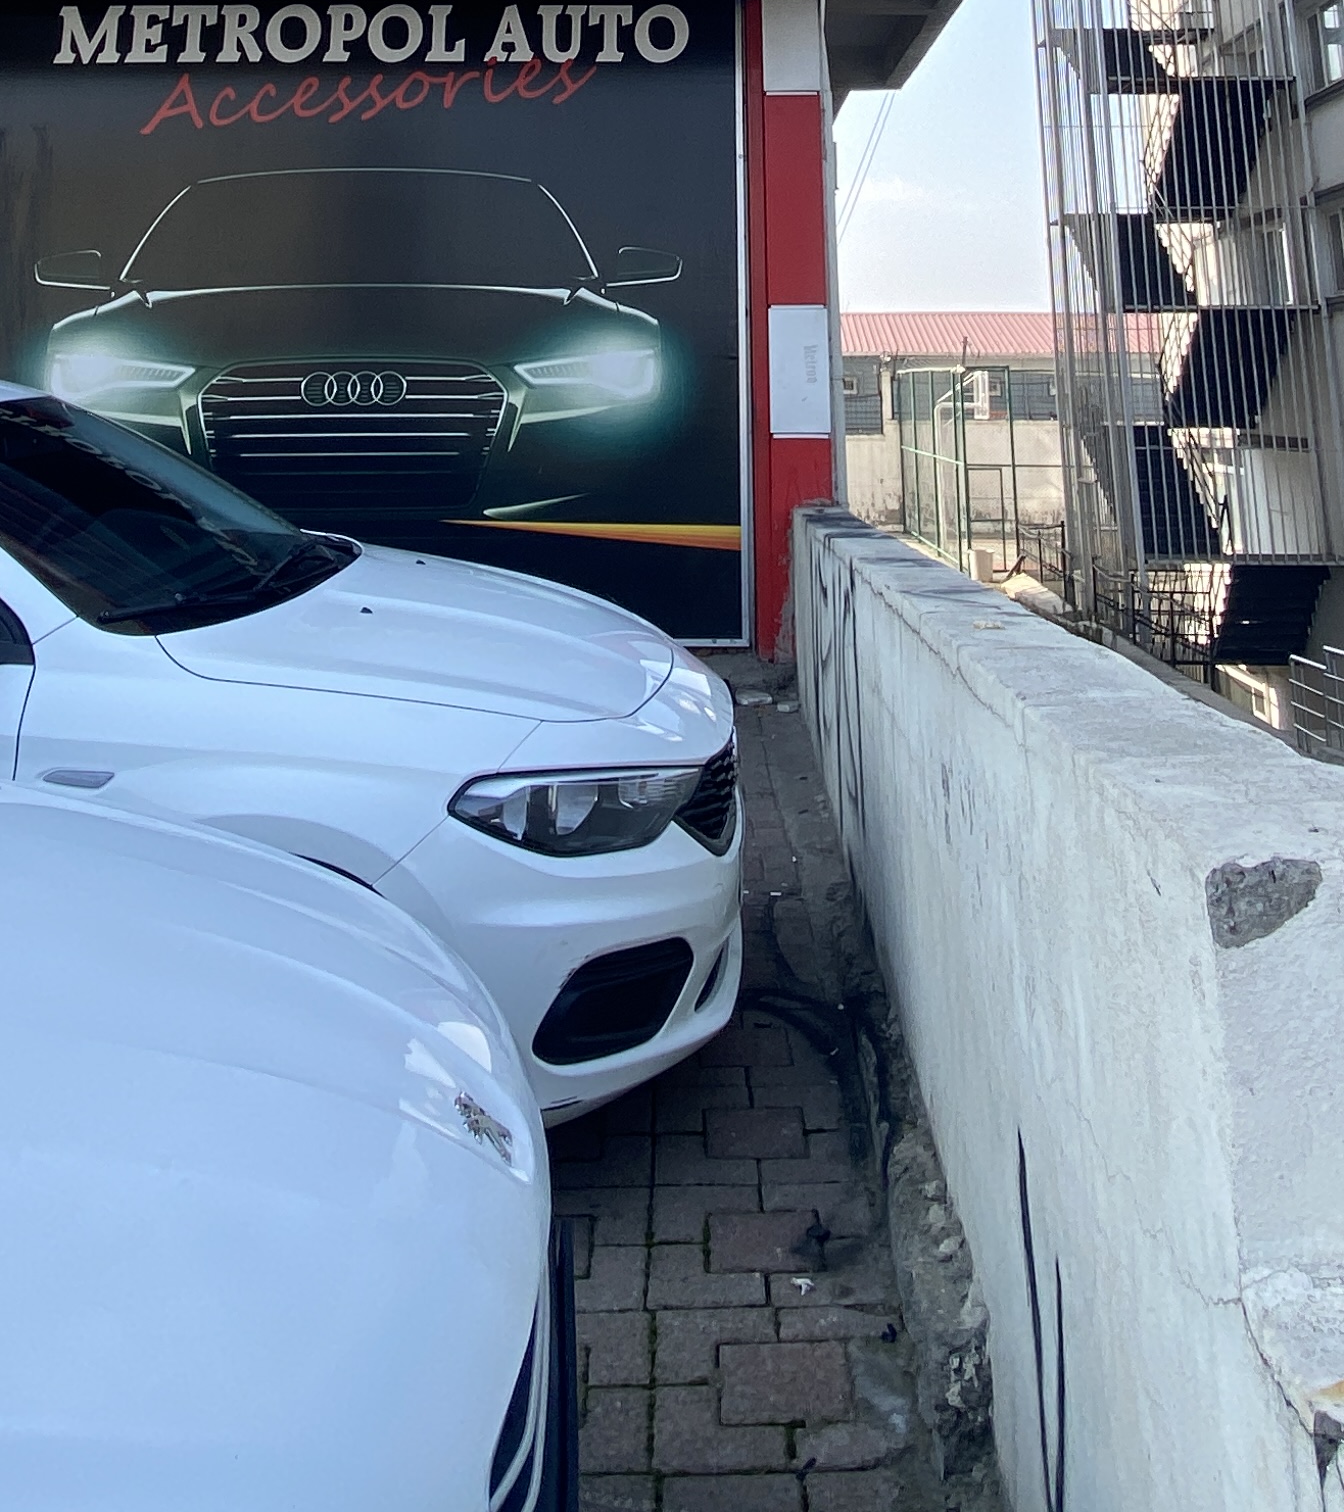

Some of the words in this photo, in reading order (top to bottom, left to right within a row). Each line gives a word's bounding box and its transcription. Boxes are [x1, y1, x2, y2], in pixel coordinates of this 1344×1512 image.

[53, 3, 465, 65] METROPOL
[483, 3, 690, 64] AUTO
[139, 54, 597, 135] Accessories
